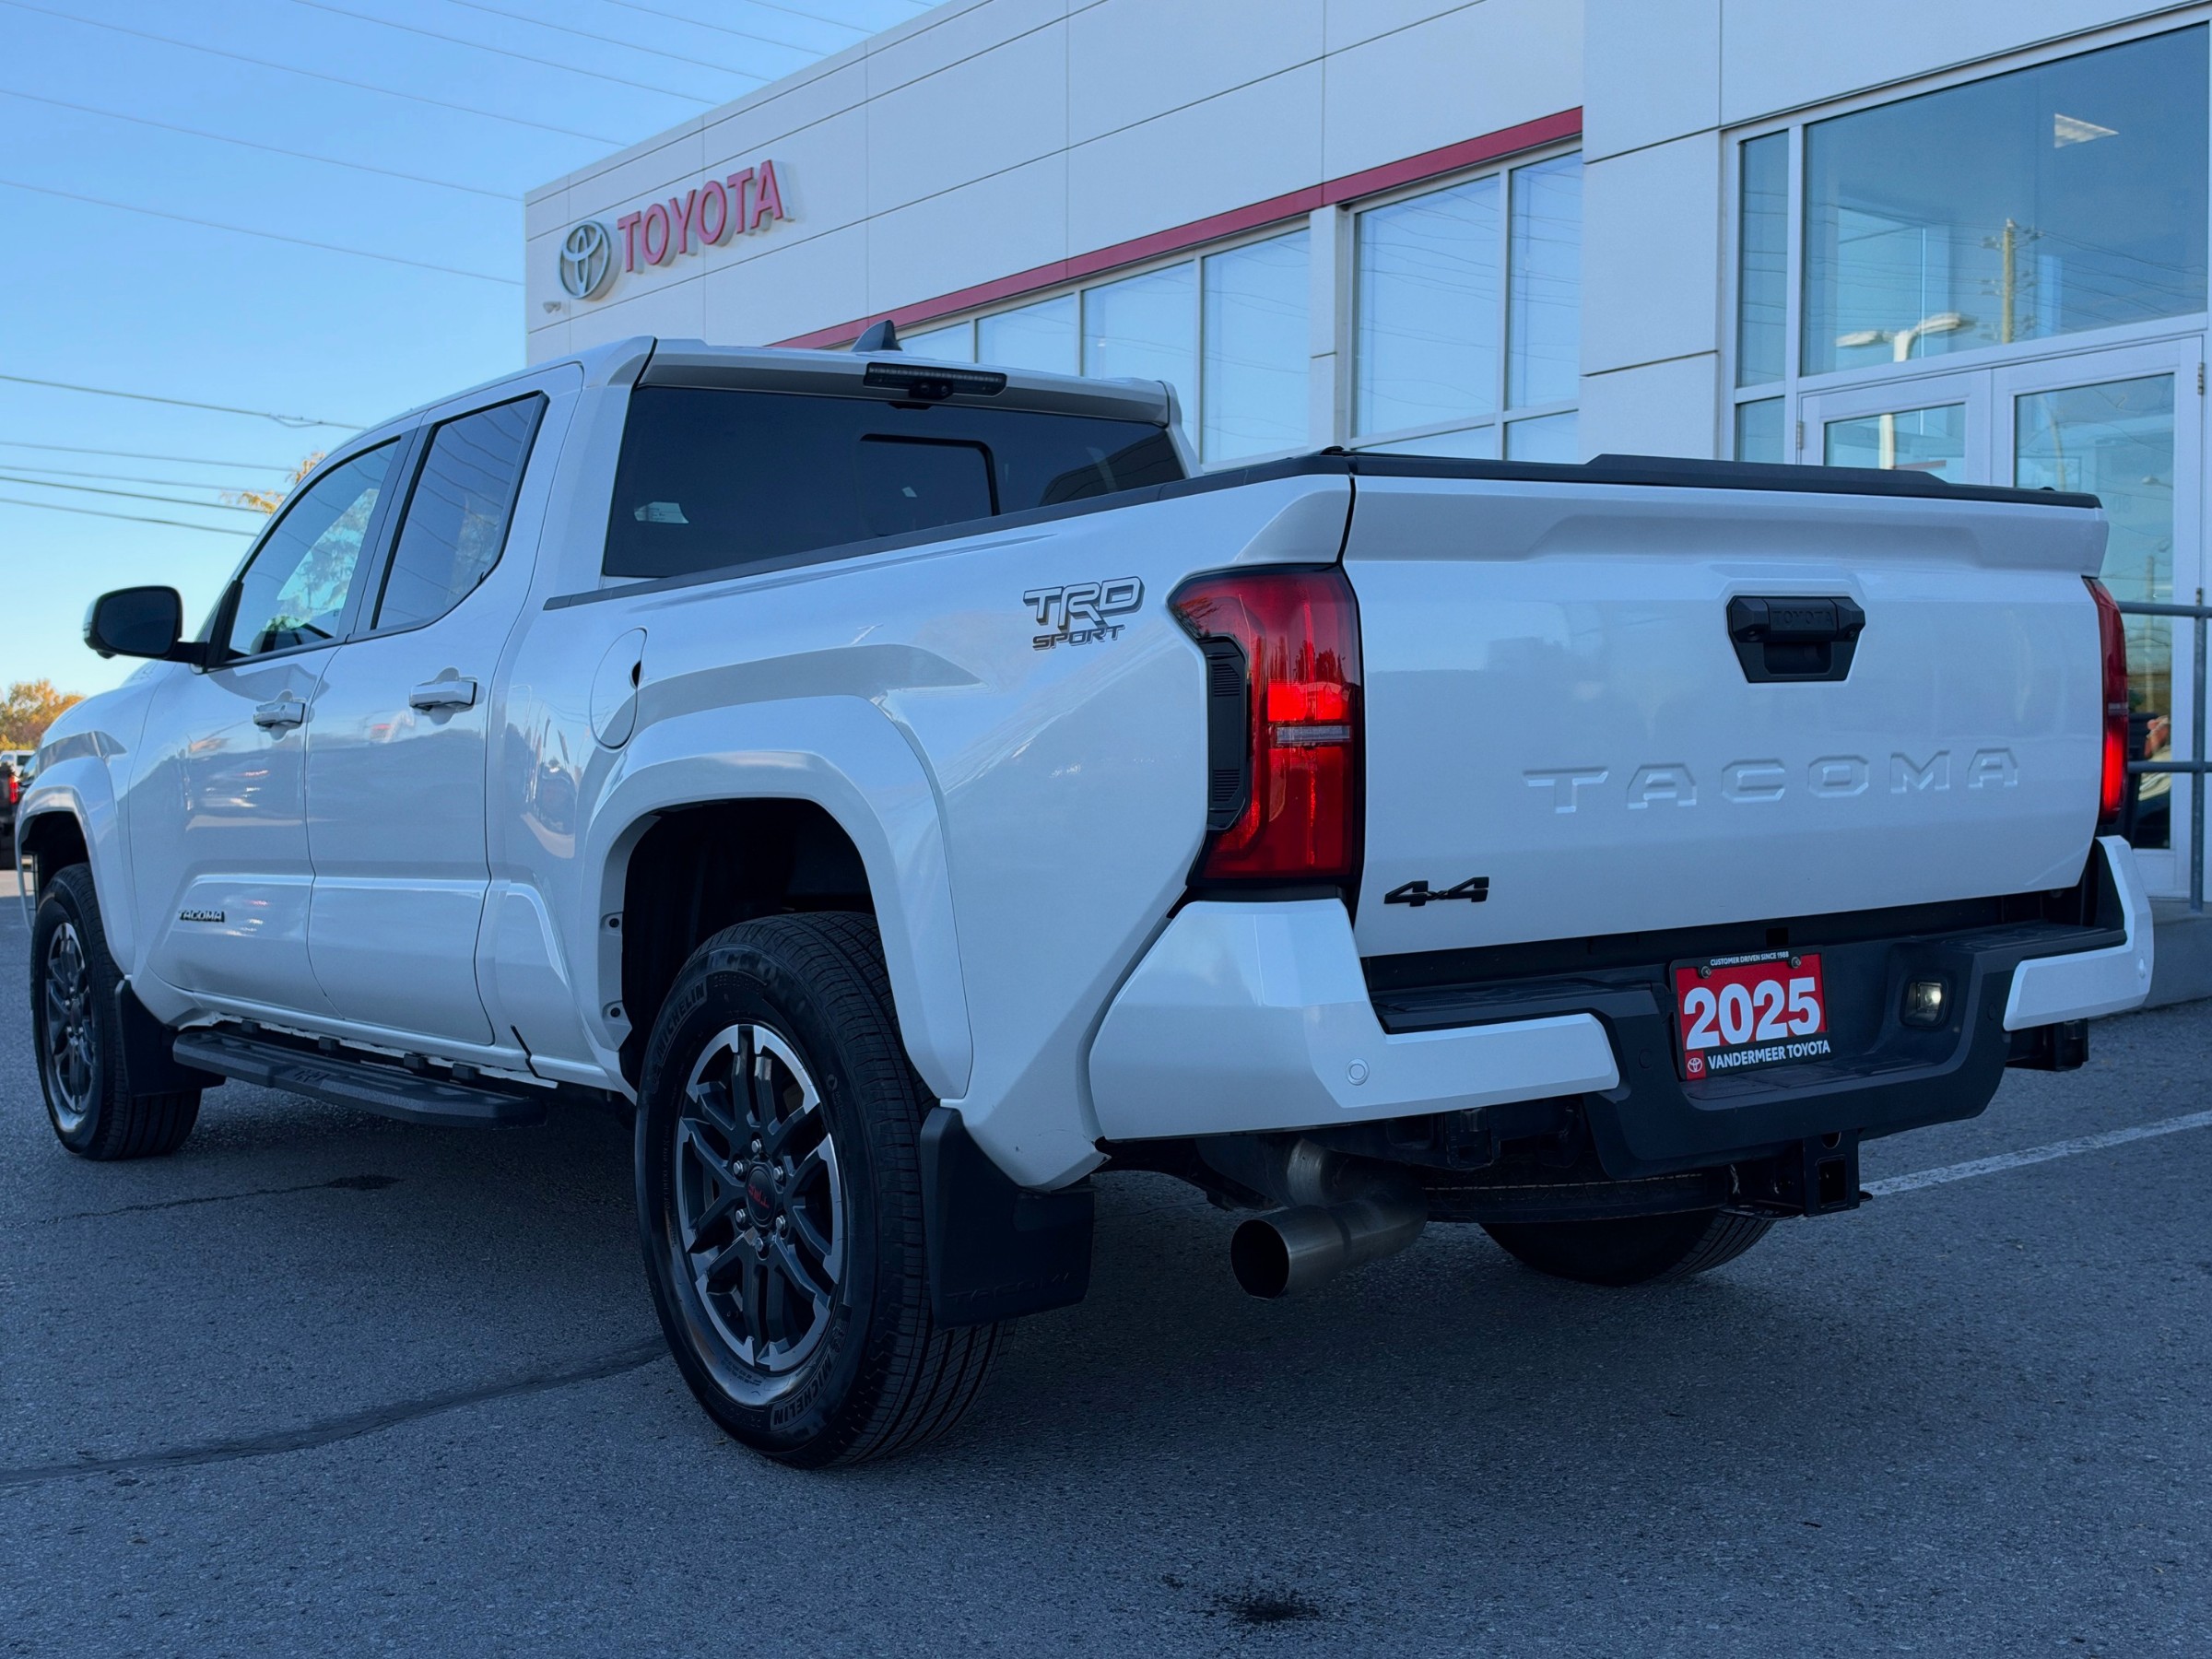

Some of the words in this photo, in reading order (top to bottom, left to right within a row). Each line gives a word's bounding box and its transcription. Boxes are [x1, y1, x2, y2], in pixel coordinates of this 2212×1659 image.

[617, 159, 783, 273] TOYOTA
[1023, 575, 1145, 631] TRD
[1771, 610, 1835, 628] TOYOTA
[1032, 624, 1125, 651] SPORT
[1523, 747, 2019, 814] TACOMA
[179, 910, 225, 923] TACOMA
[1710, 957, 1740, 967] CUSTOMER
[1740, 954, 1760, 964] DRIVEN
[1760, 952, 1777, 961] SINCE
[655, 981, 705, 1061] MICHELIN
[1684, 977, 1821, 1050] 2025
[1708, 1046, 1786, 1070] VANDERMEER
[1786, 1040, 1831, 1058] TOYOTA
[773, 1354, 833, 1427] MICHELIN
